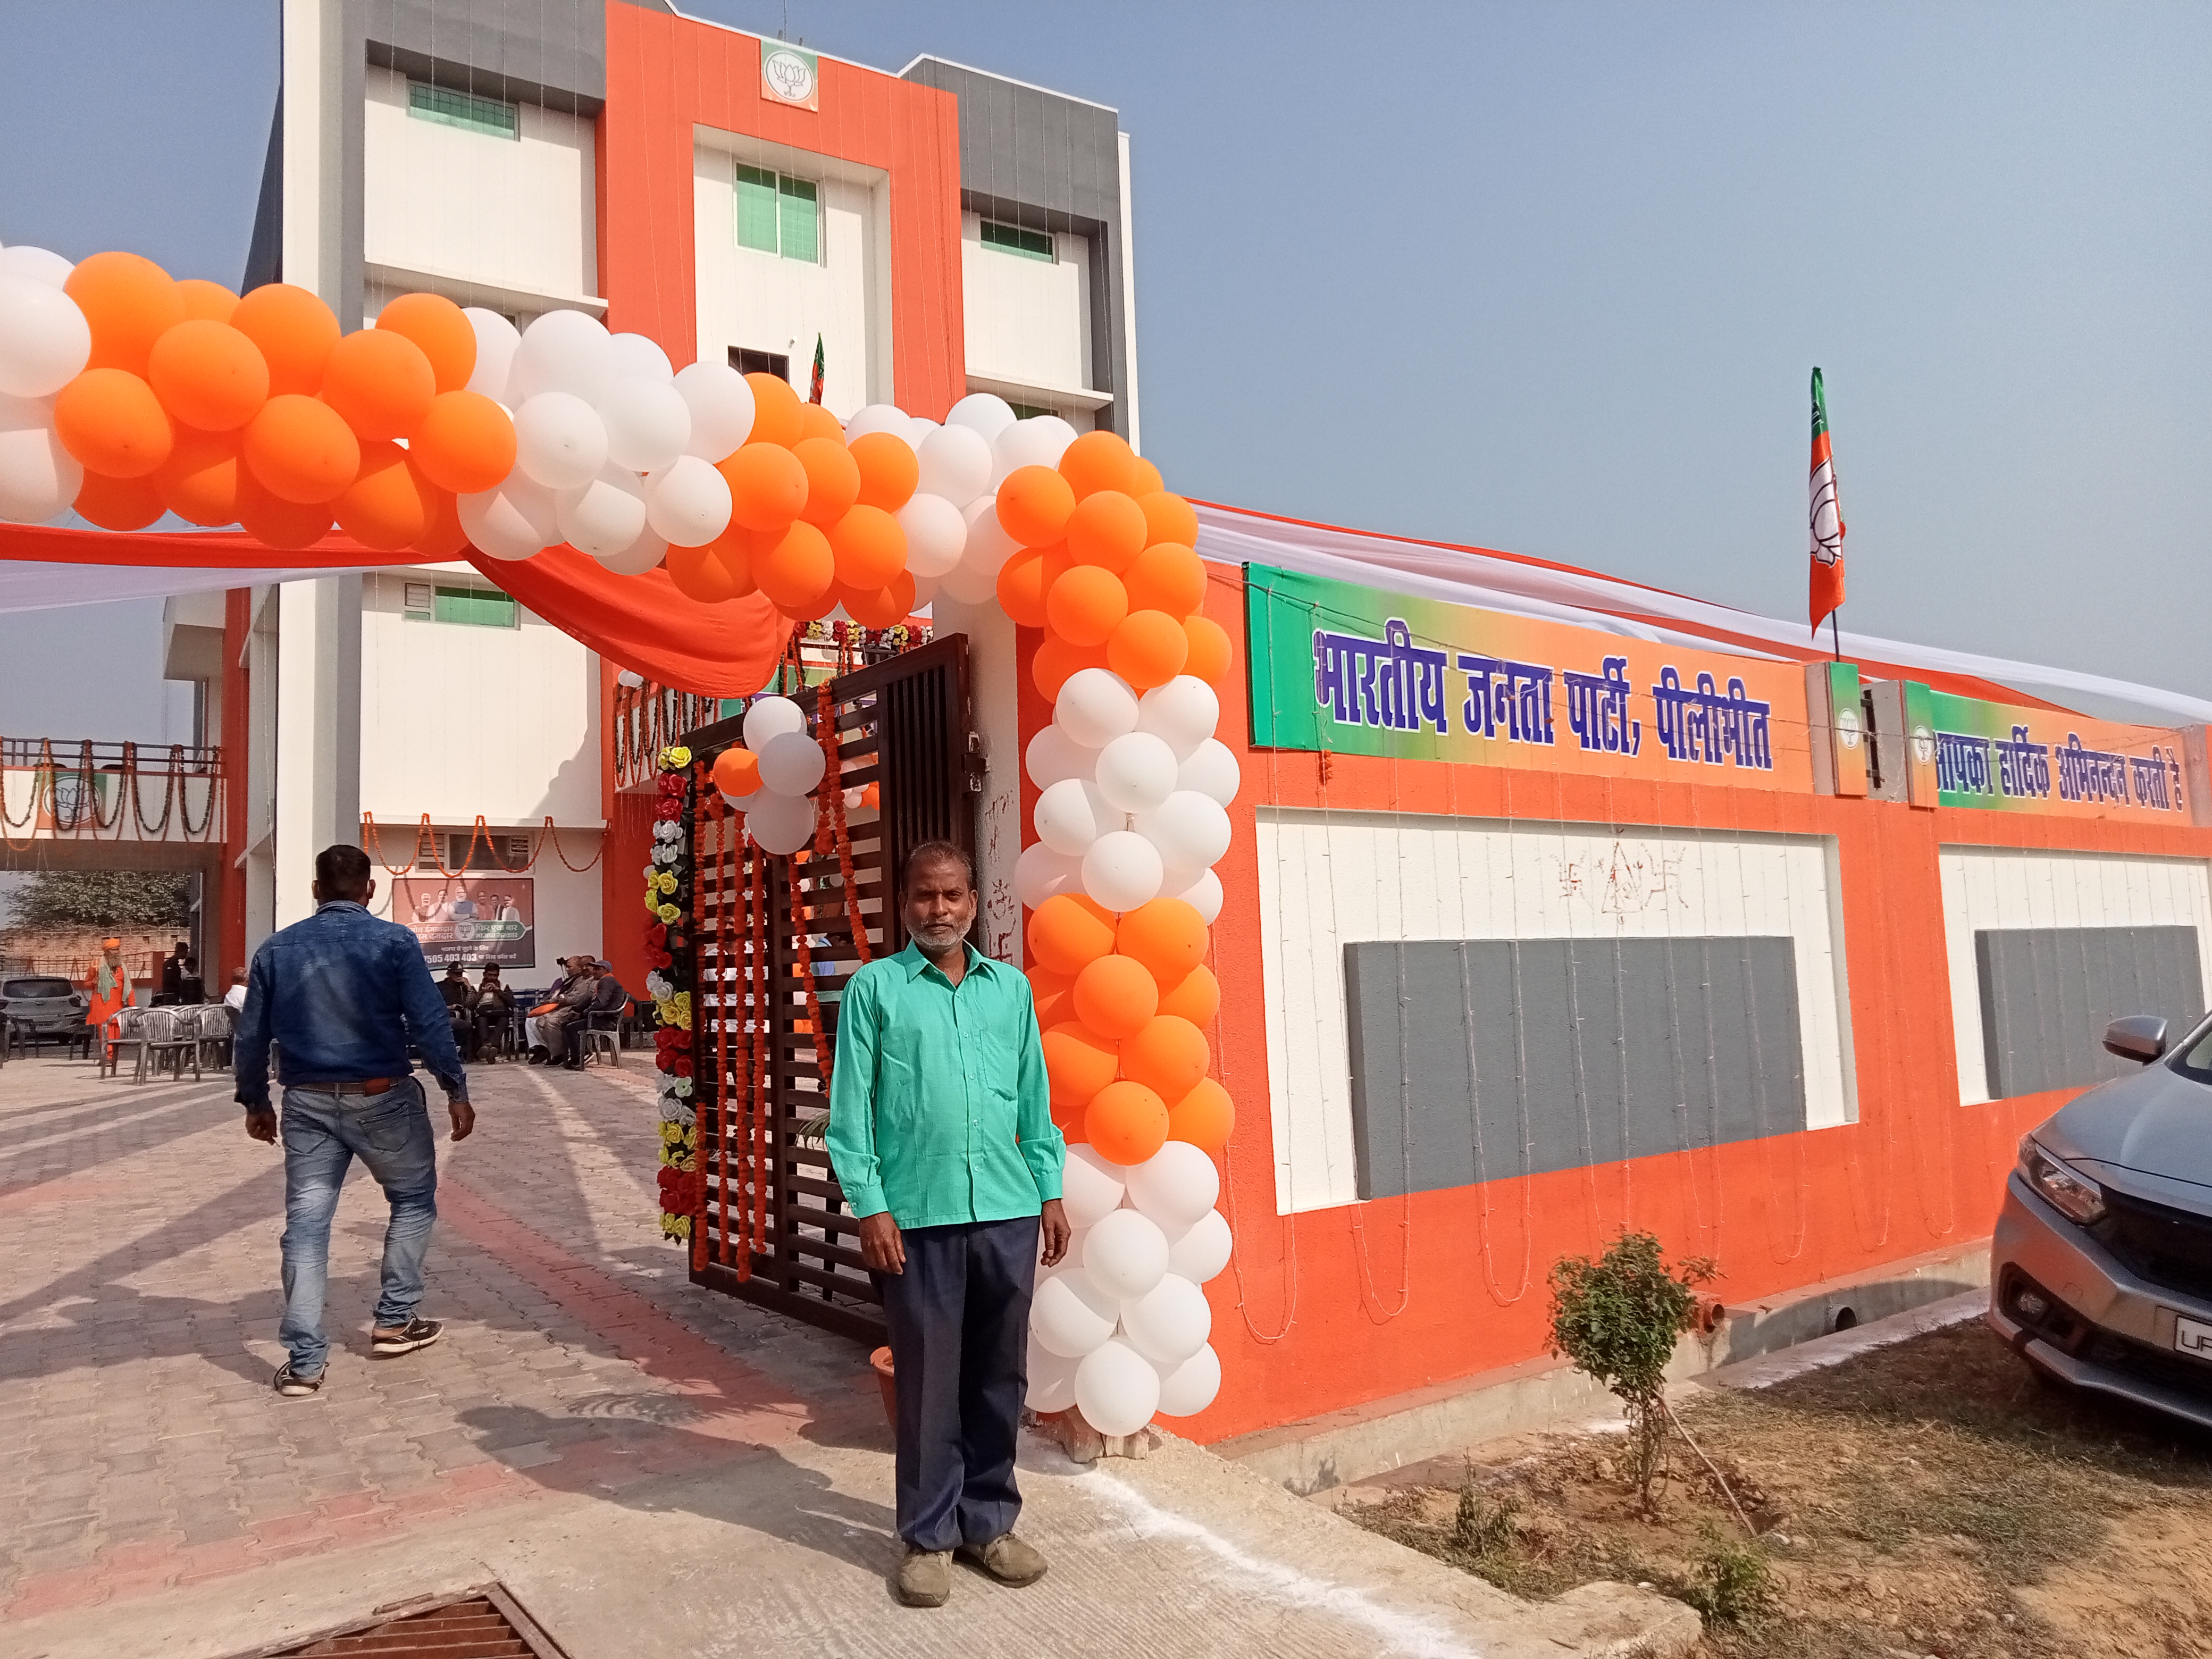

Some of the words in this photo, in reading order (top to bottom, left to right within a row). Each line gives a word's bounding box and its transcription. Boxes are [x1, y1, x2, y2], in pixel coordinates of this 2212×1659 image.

[1312, 616, 1448, 736] भारतीय
[1456, 652, 1555, 747] जनता
[1562, 654, 1641, 758] पार्टी,
[1651, 664, 1773, 772] पीलीभीत
[1993, 724, 2051, 800] हार्दिक
[2054, 731, 2131, 807] अभिनन्दन
[2128, 745, 2171, 811] करती
[2164, 746, 2183, 812] है
[491, 925, 504, 933] एक
[444, 953, 460, 962] 403
[461, 953, 477, 962] 403
